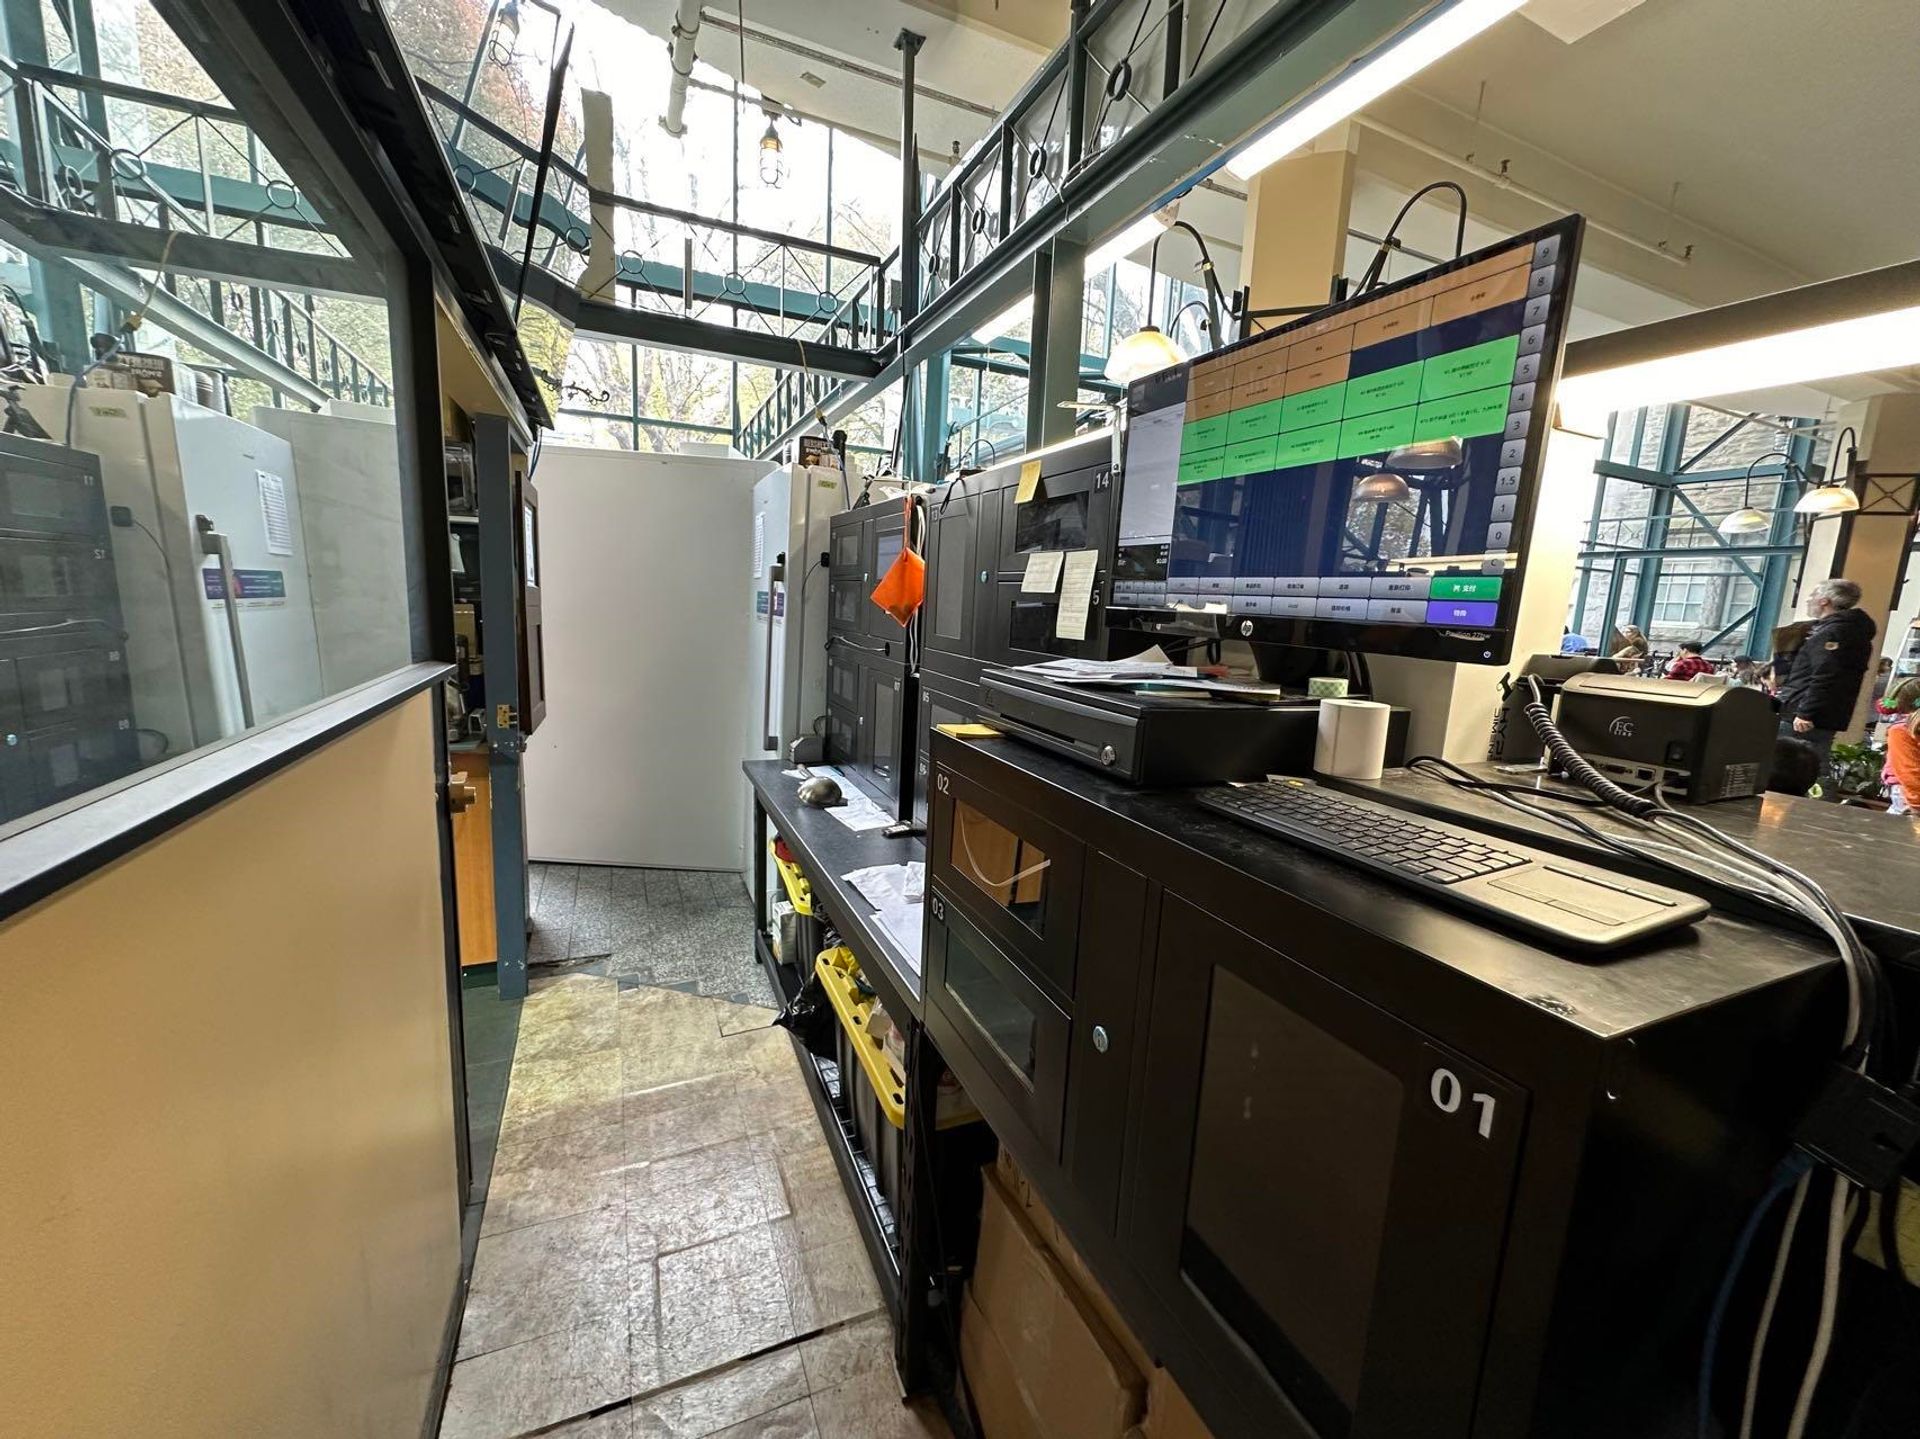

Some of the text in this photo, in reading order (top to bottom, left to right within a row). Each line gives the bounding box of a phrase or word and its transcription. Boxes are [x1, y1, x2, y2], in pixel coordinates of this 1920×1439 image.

[1542, 247, 1550, 259] 9
[1537, 276, 1545, 288] 8
[1532, 306, 1541, 316] 7
[1528, 335, 1535, 345] 6
[1522, 364, 1530, 375] 5
[1518, 392, 1526, 402] 4
[1513, 421, 1521, 431] 3
[1509, 448, 1516, 458] 2
[1095, 471, 1110, 490] 14
[1500, 476, 1516, 486] 1.5
[1495, 531, 1502, 541] 0
[937, 772, 950, 796] 02
[931, 896, 944, 921] 03
[1430, 1067, 1497, 1140] 01
